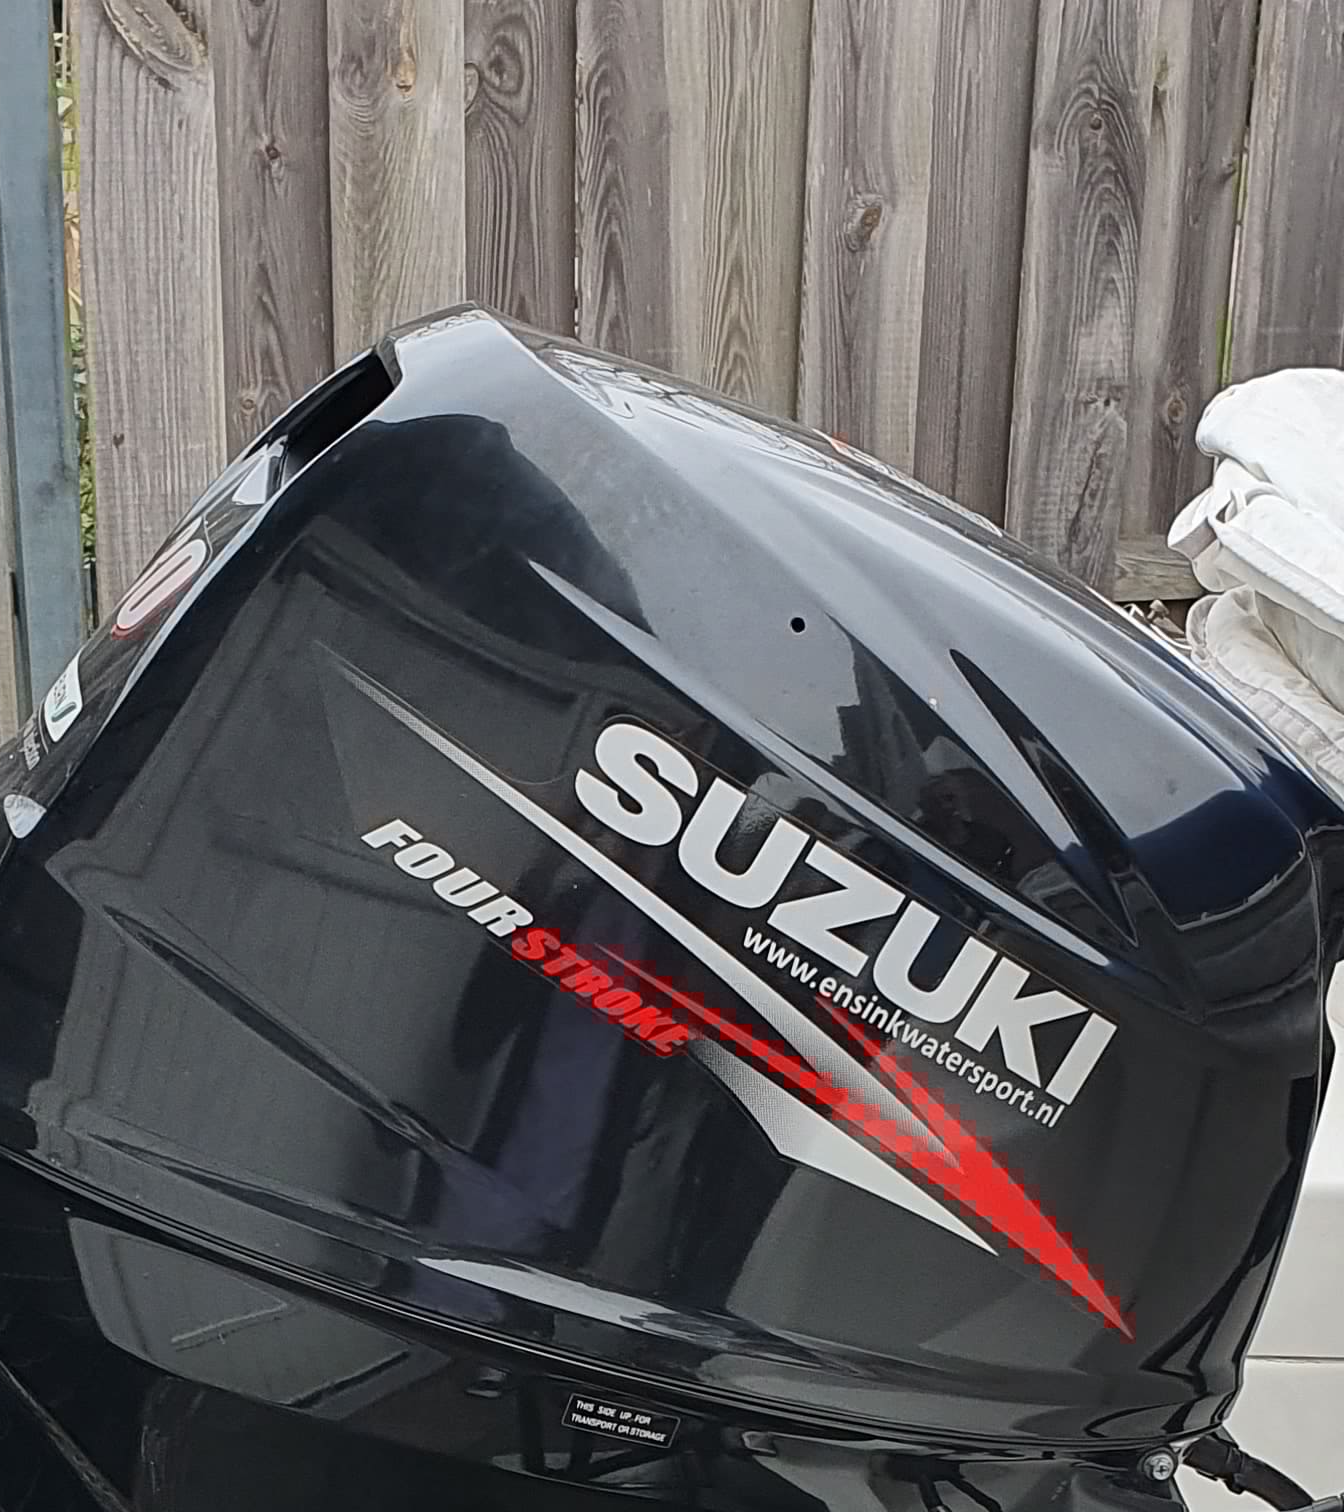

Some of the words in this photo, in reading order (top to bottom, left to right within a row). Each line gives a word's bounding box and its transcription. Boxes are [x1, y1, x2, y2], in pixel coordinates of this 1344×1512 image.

[360, 818, 534, 938] FOUR
[511, 929, 689, 1059] STROKE
[575, 722, 1118, 1106] SUZUKI
[742, 924, 1066, 1129] www.ensinkwatersport.nl
[571, 1413, 618, 1431] TRANSPORT
[618, 1424, 630, 1435] OR
[630, 1427, 667, 1442] STORAGE
[576, 1400, 595, 1412] THIS
[597, 1405, 617, 1418] SIDE
[634, 1414, 652, 1425] FOR
